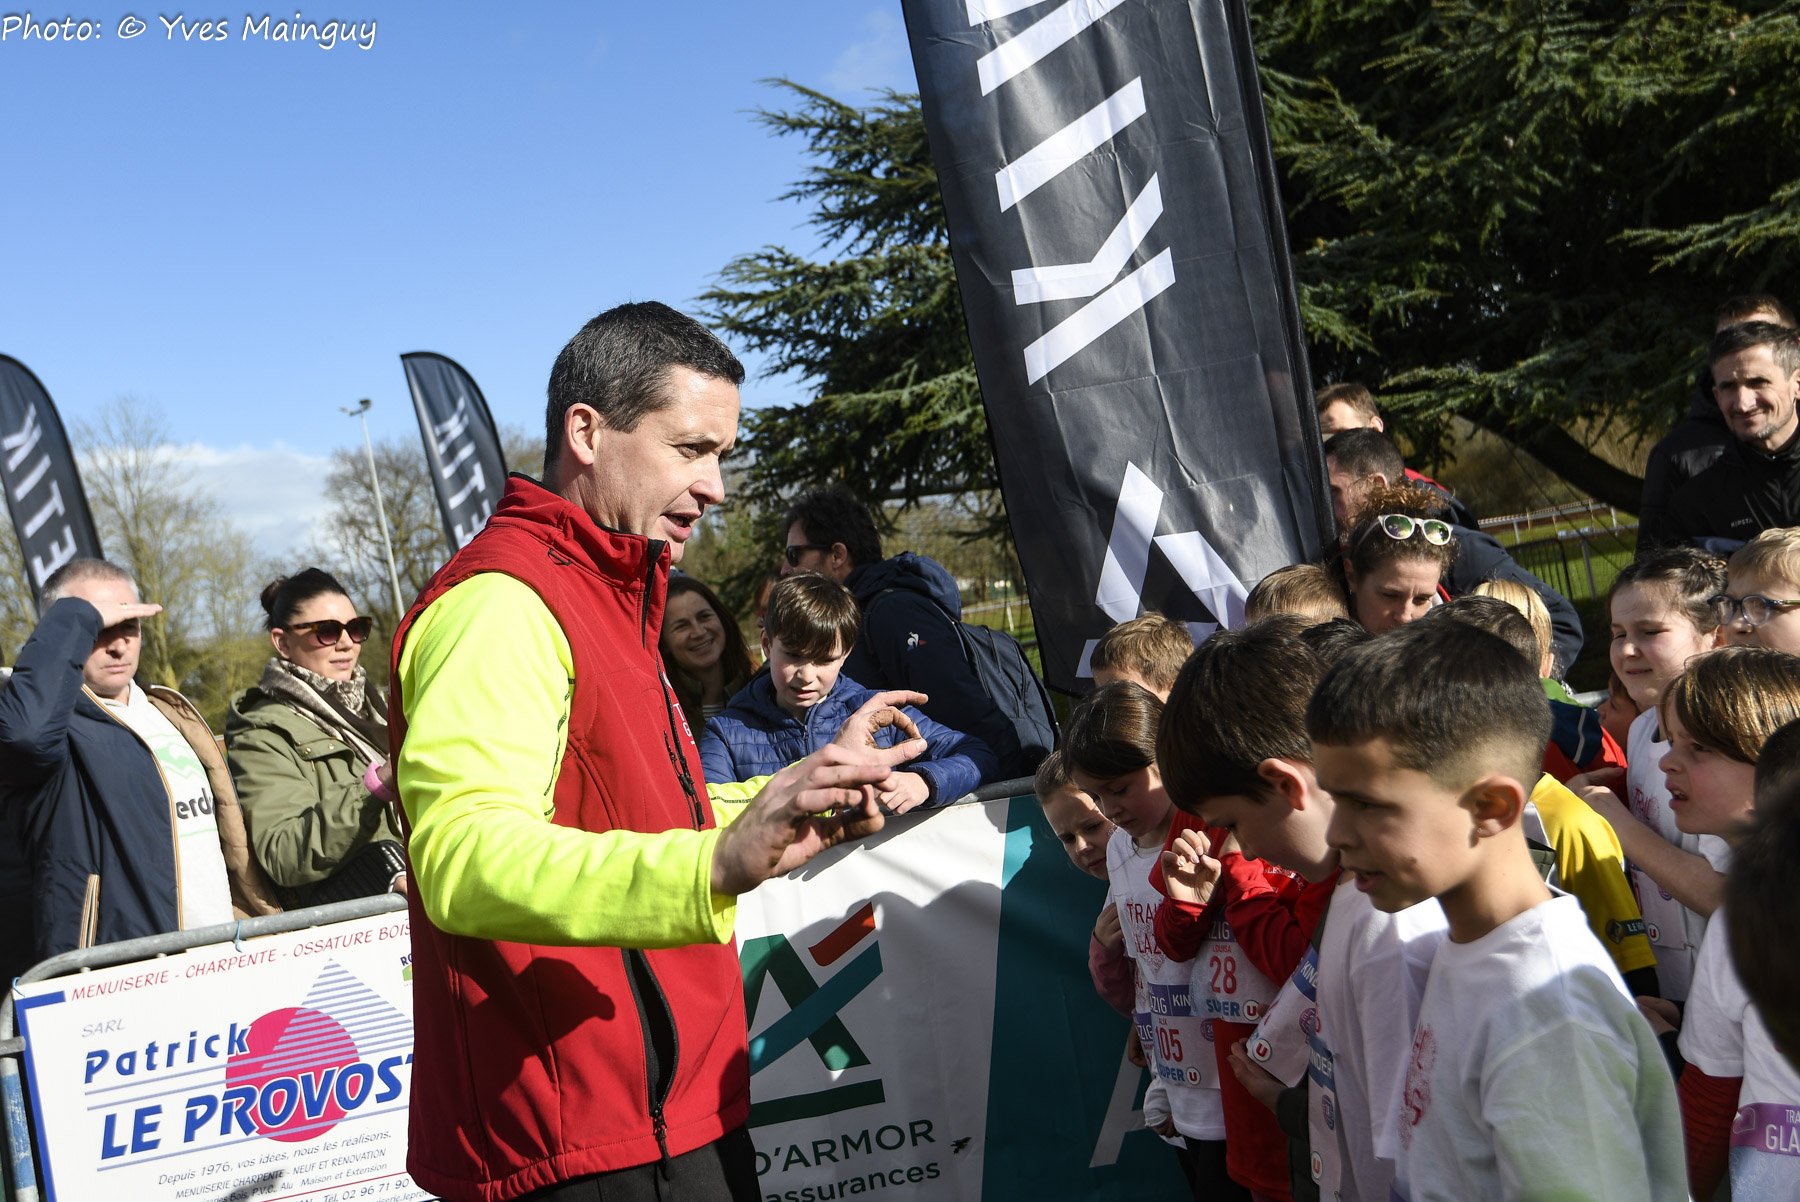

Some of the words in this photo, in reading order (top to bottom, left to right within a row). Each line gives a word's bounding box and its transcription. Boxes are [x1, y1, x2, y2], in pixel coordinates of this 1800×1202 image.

[71, 970, 169, 1001] MENUISERIE
[185, 949, 277, 980] CHARPENTE
[292, 929, 374, 958] OSSATURE
[1209, 955, 1237, 995] 28
[81, 1018, 126, 1039] SARL
[1155, 1026, 1184, 1063] 105
[84, 1022, 251, 1085] Patrick
[100, 1104, 163, 1161] LE
[159, 1170, 196, 1188] Depuis
[238, 1158, 256, 1168] vos
[294, 1144, 320, 1157] nous
[323, 1141, 338, 1151] les
[176, 1180, 230, 1199] MENUISERIE
[233, 1169, 285, 1187] CHARPENTE
[293, 1164, 316, 1175] NEUF
[319, 1160, 329, 1169] ET
[301, 1175, 332, 1186] Maison
[335, 1171, 344, 1179] et
[346, 1162, 388, 1177] Extension
[343, 1189, 356, 1200] 02
[361, 1185, 375, 1196] 96
[379, 1182, 390, 1192] 71
[396, 1178, 410, 1190] 90
